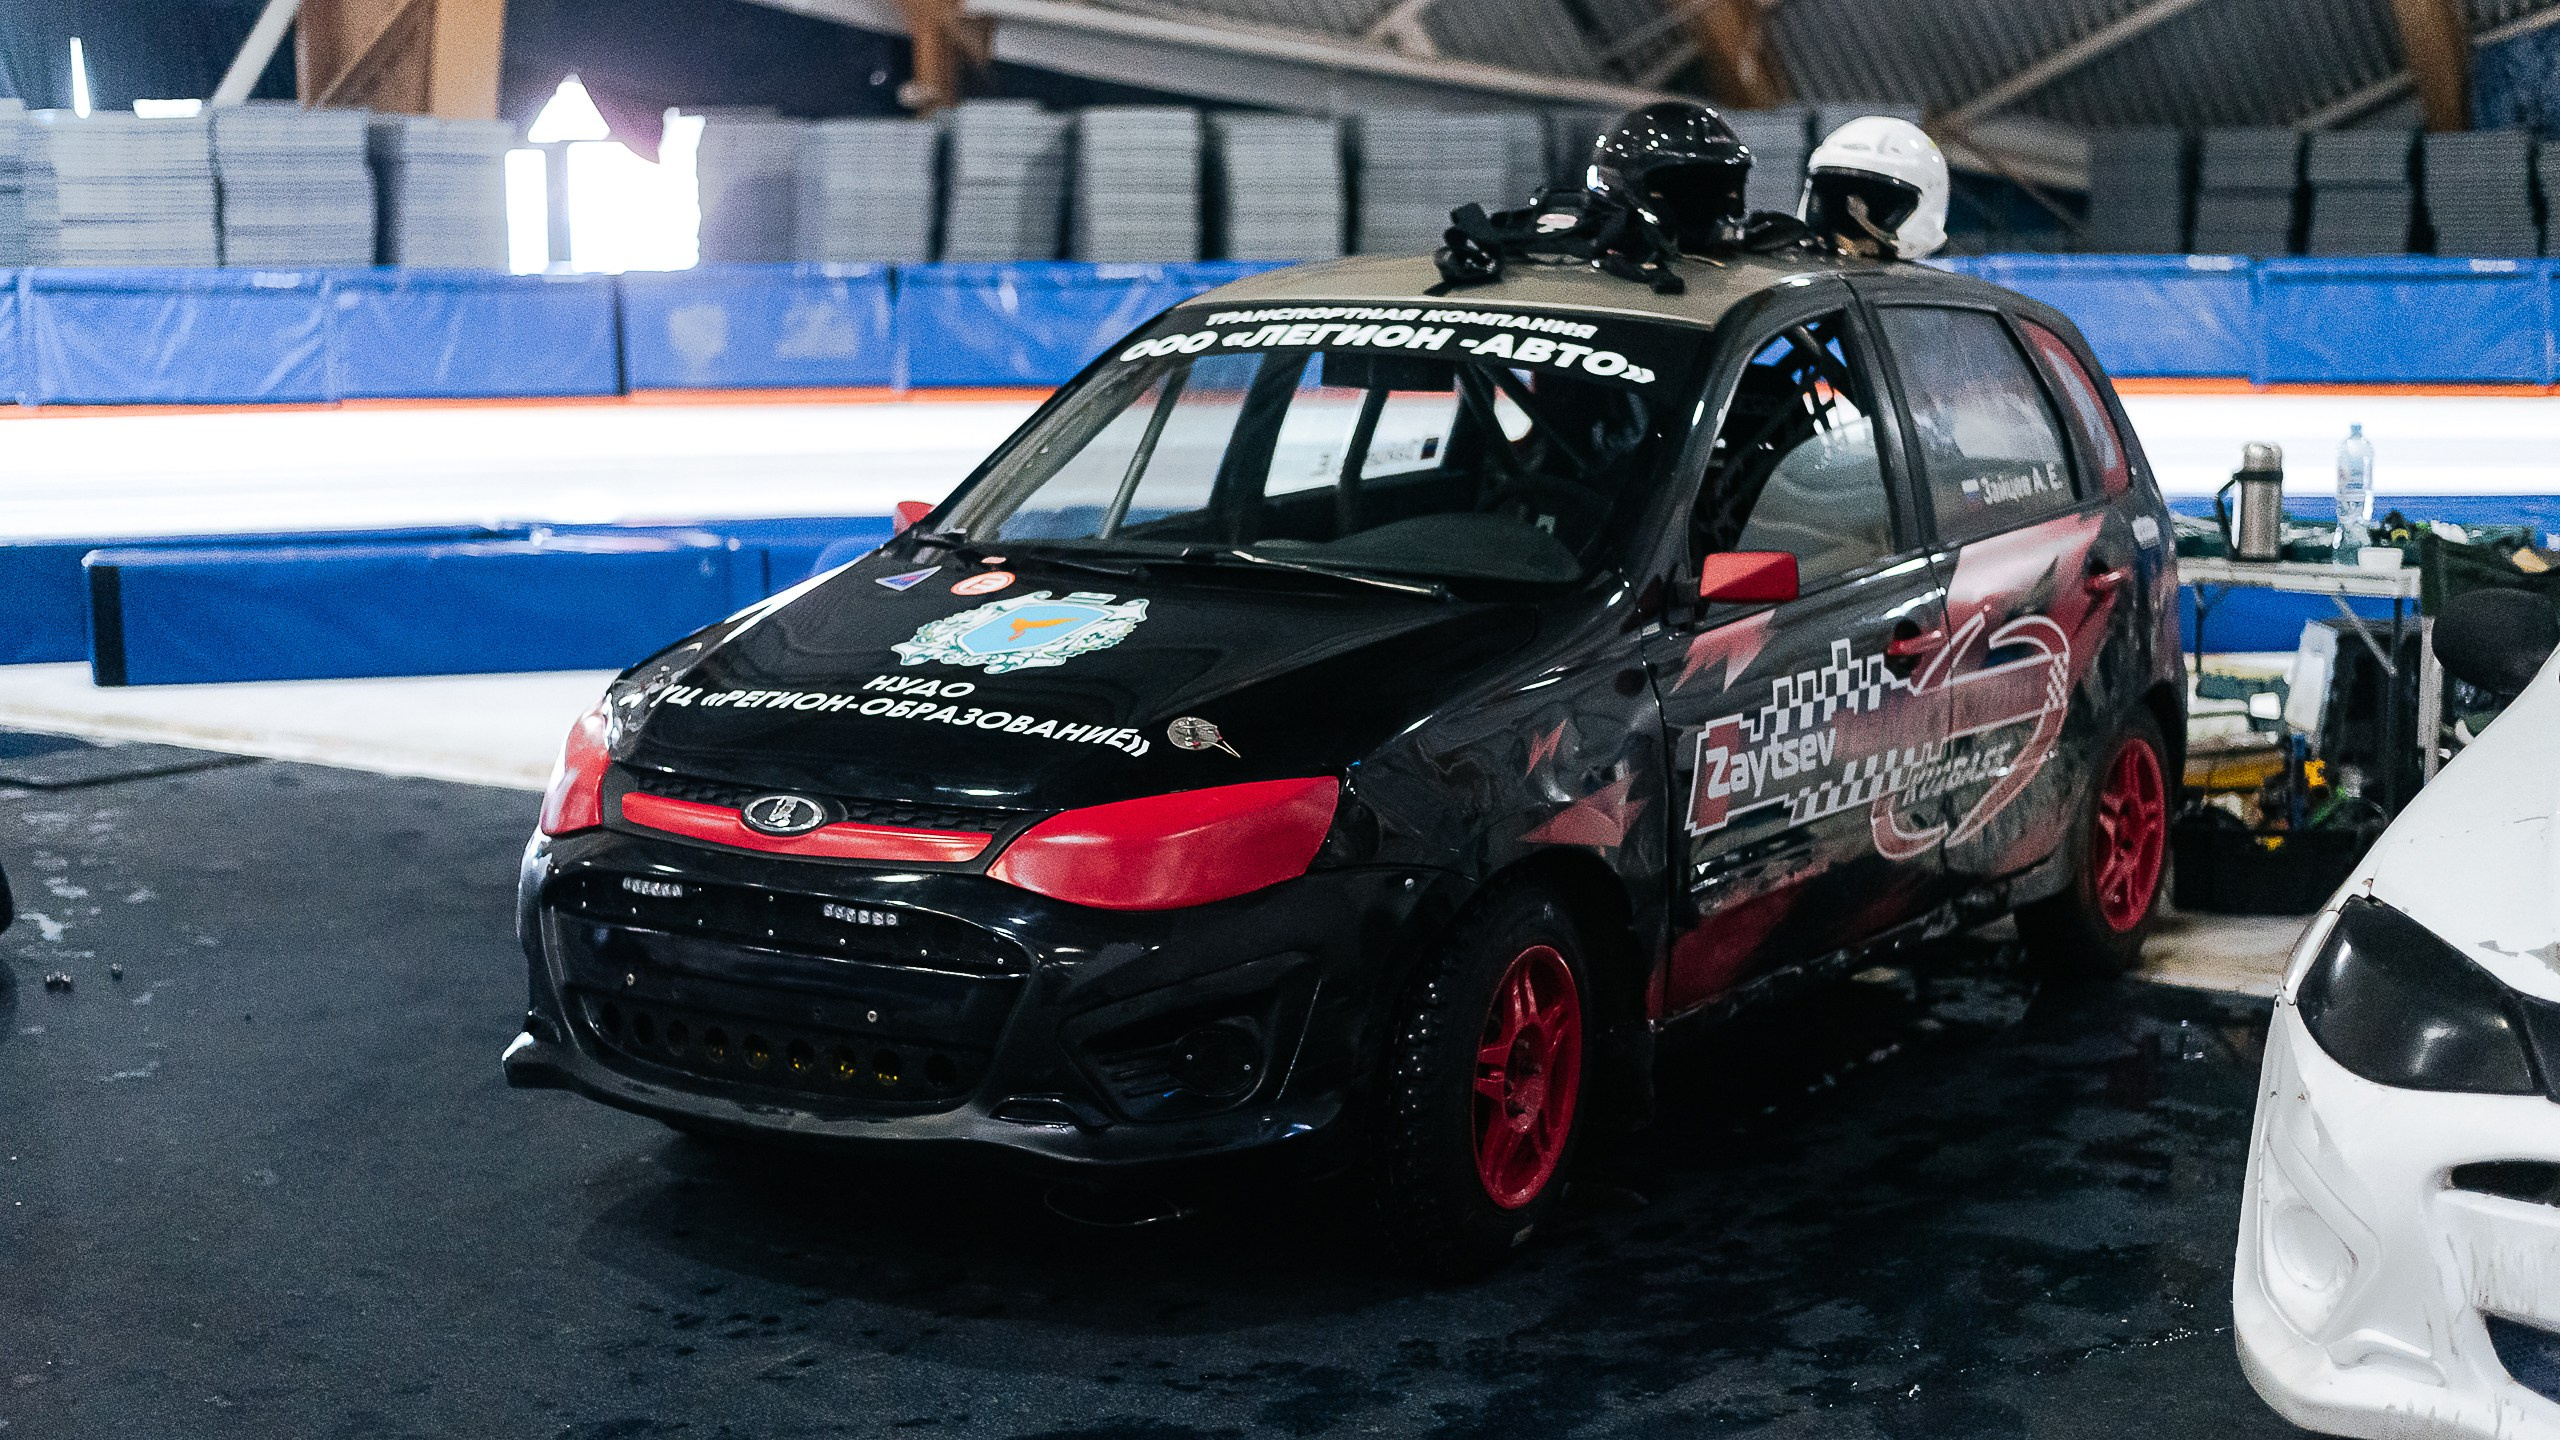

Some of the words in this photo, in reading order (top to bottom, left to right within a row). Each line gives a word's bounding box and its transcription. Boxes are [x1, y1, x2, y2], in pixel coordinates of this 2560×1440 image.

[1119, 329, 1219, 362] ООО
[1221, 323, 1456, 351] «ЛЕГИОН
[1459, 333, 1656, 384] -АВТО»
[1205, 306, 1423, 327] ТРАНСПОРТНАЯ
[1421, 308, 1599, 340] КОМПАНИЯ
[862, 674, 976, 699] НУДО
[700, 688, 1151, 758] «РЕГИОН-ОБРАЗОВАНИЕ»
[1705, 727, 1837, 801] Zaytsev
